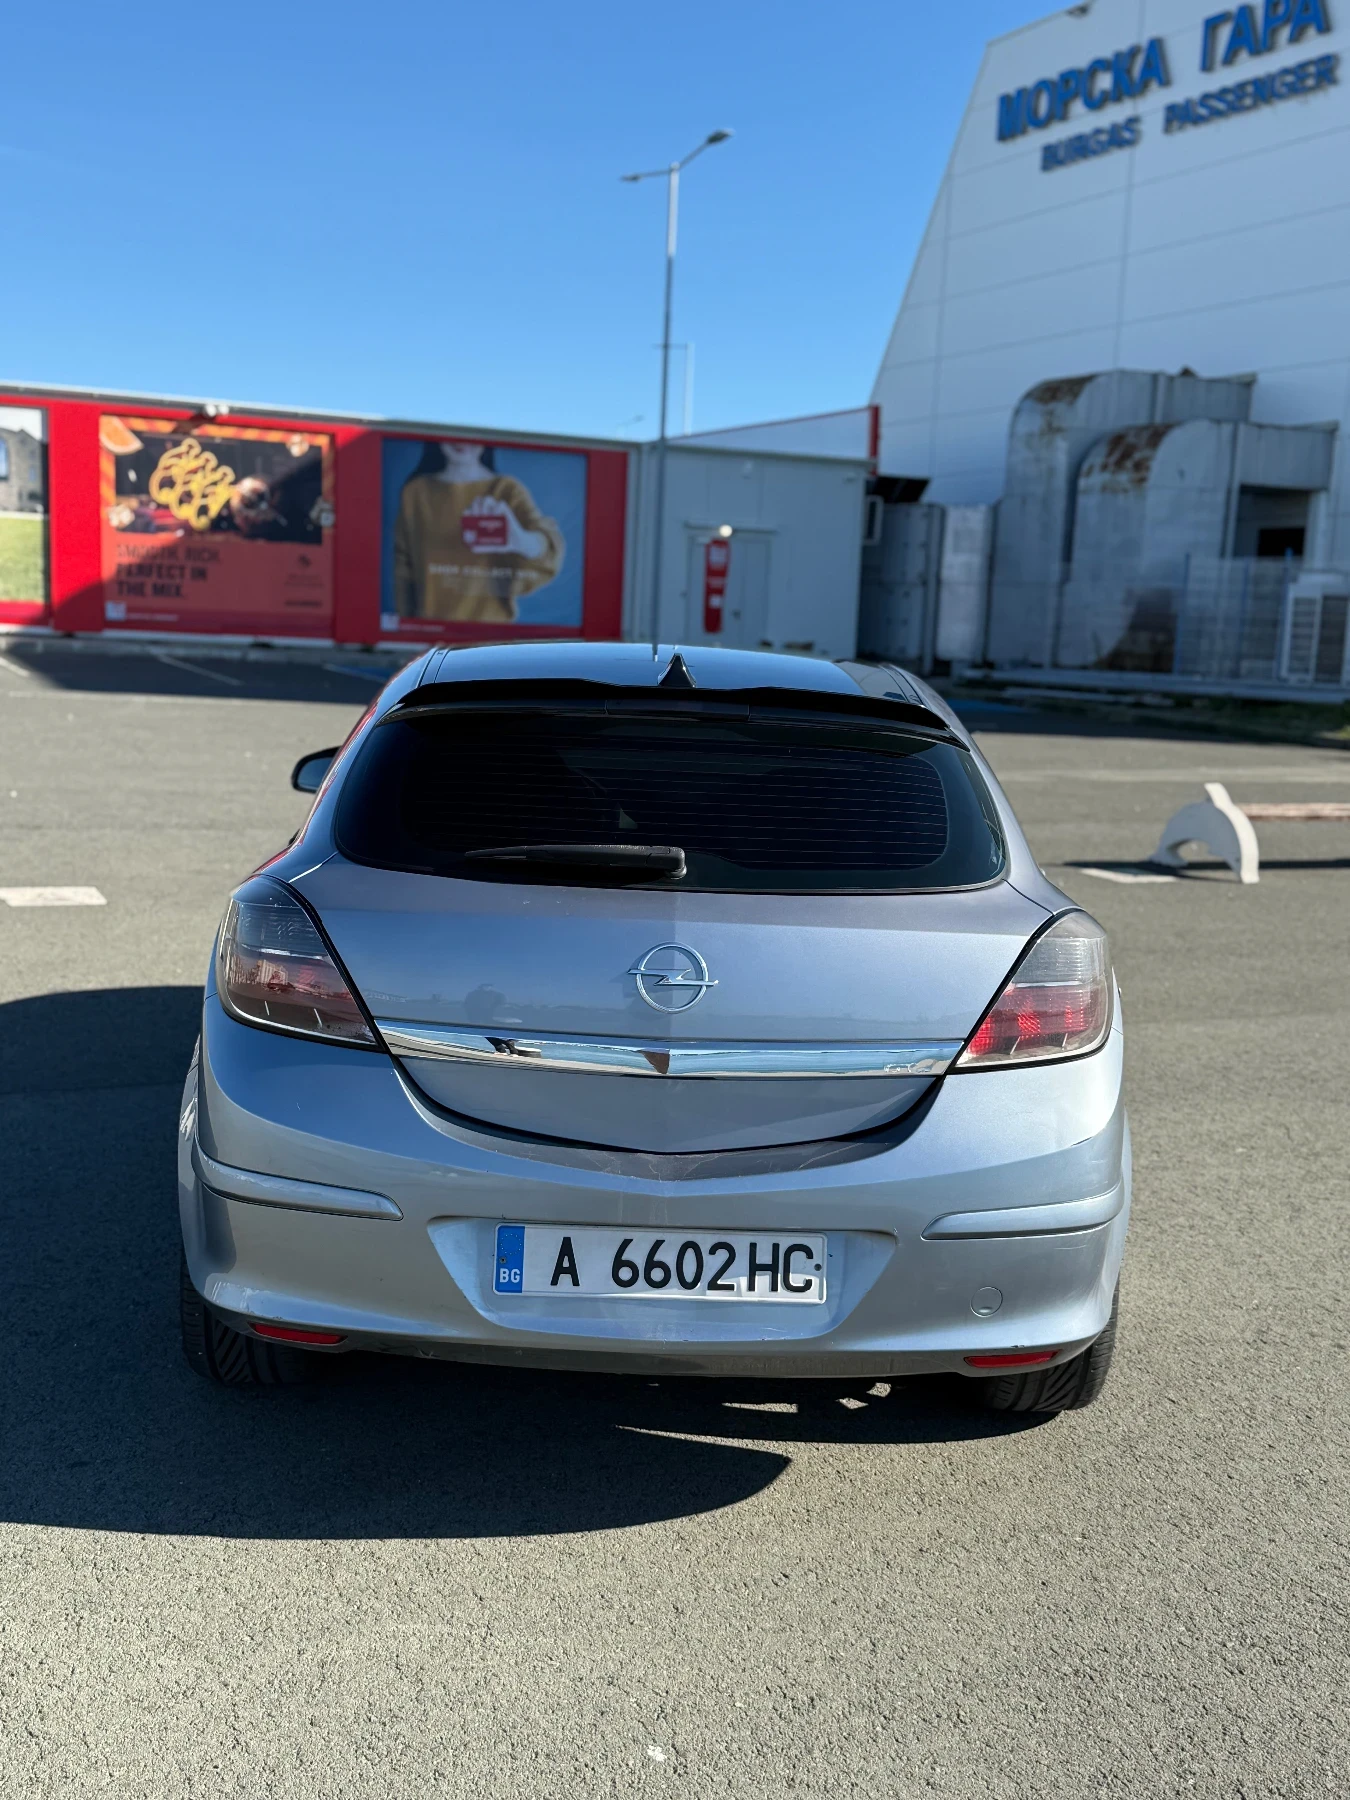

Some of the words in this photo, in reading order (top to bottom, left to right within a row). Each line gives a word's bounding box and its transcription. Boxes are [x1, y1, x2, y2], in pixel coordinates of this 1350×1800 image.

[996, 37, 1172, 142] МОРСКА
[1200, 0, 1333, 73] ГАРА
[1041, 115, 1143, 172] BURGAS
[1163, 53, 1341, 134] PASSENGER
[499, 1267, 520, 1283] BG
[550, 1236, 580, 1287] A
[611, 1238, 737, 1292] 6602
[748, 1242, 815, 1293] HC
